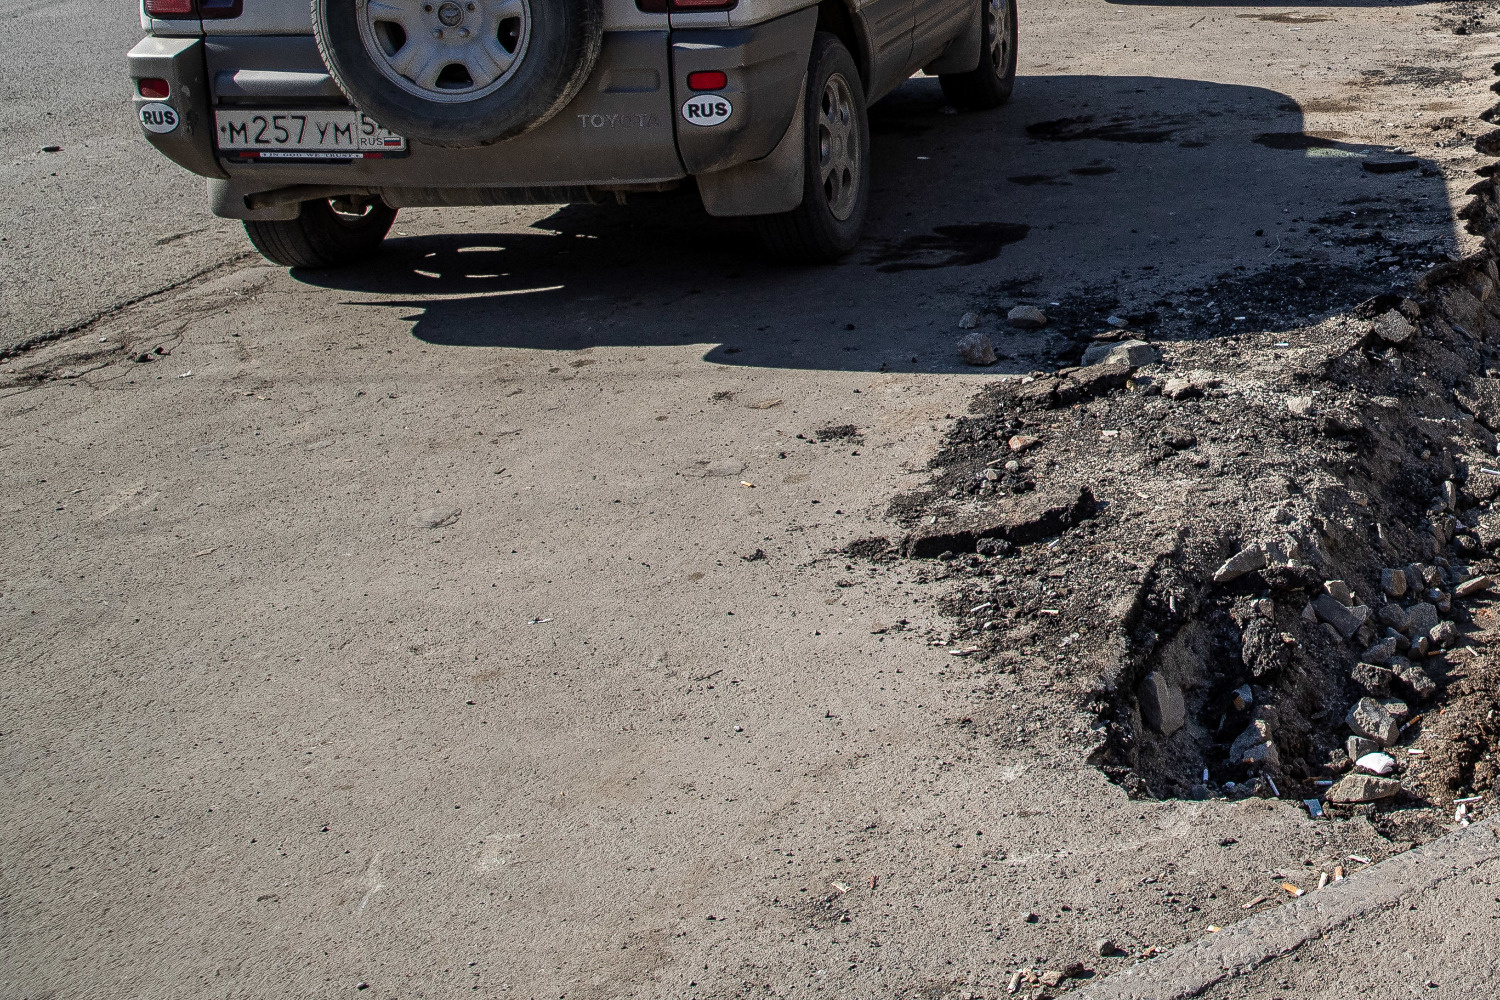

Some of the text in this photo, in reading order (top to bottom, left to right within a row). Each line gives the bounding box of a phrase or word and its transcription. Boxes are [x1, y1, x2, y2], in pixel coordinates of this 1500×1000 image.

[687, 102, 728, 118] RUS
[142, 111, 176, 126] RUS
[360, 137, 383, 146] RUS
